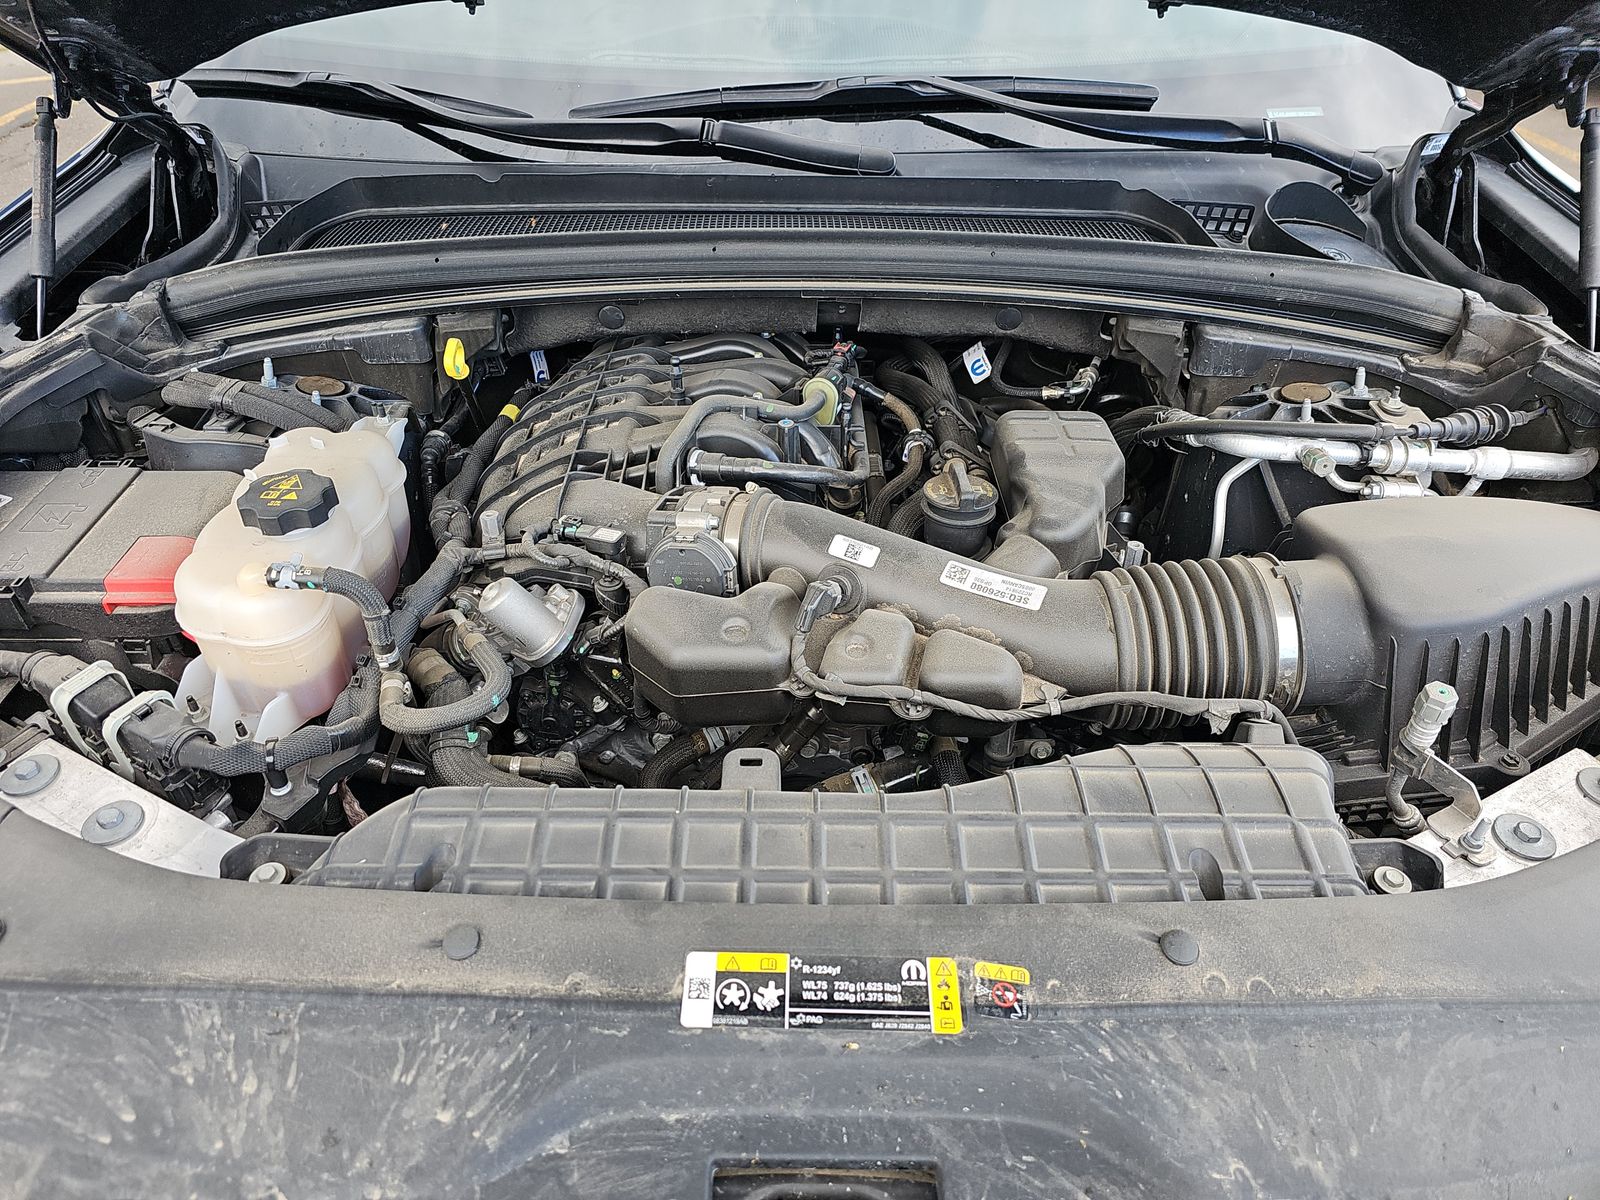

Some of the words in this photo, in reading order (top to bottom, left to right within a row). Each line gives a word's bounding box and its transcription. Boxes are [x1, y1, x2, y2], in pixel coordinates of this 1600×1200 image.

[970, 582, 1030, 605] SEQ:526080
[802, 965, 841, 977] R-1234yf
[802, 980, 828, 990] WL75
[833, 981, 856, 992] 737g
[802, 991, 828, 1001] WL74
[833, 992, 856, 1003] 624g
[806, 1015, 824, 1024] PAG
